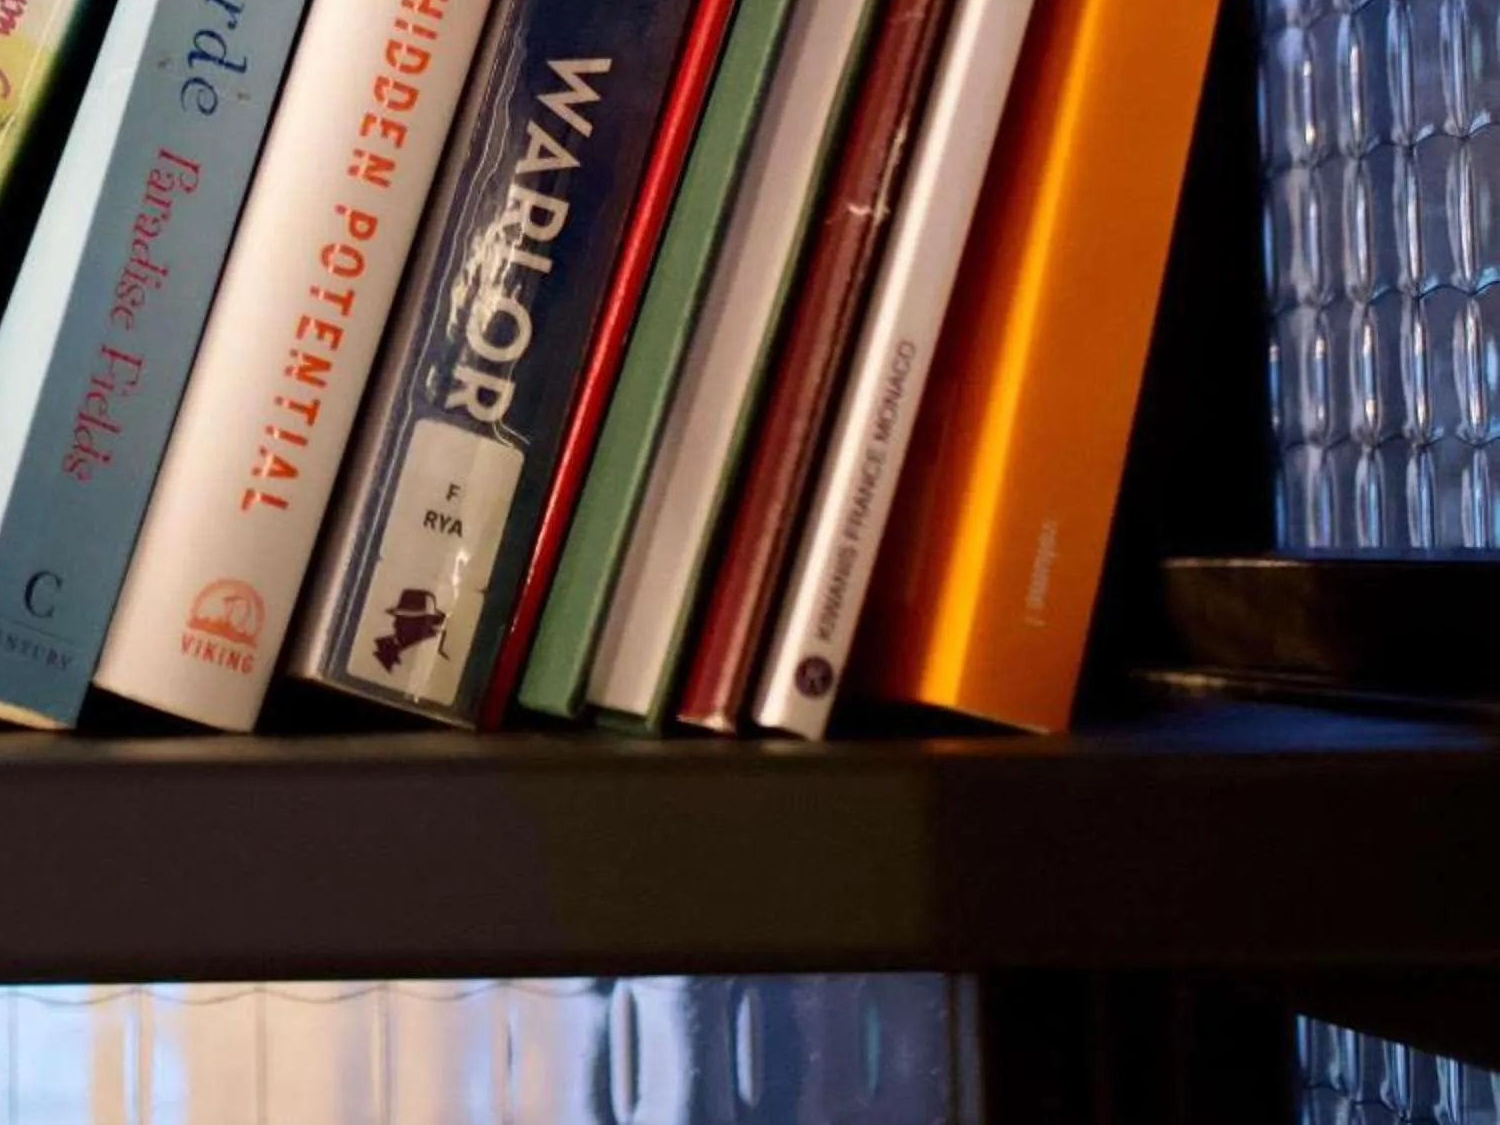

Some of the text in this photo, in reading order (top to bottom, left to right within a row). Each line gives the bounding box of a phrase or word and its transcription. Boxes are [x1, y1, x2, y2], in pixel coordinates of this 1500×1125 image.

[443, 57, 613, 426] WARLOR
[62, 146, 201, 482] Paradise Fields
[240, 202, 379, 514] POTENTIAL
[445, 482, 461, 502] F
[845, 445, 888, 541] FRANCE
[874, 340, 917, 445] MONACO
[423, 509, 463, 538] RYA
[23, 570, 63, 619] C
[180, 630, 256, 674] VIKING
